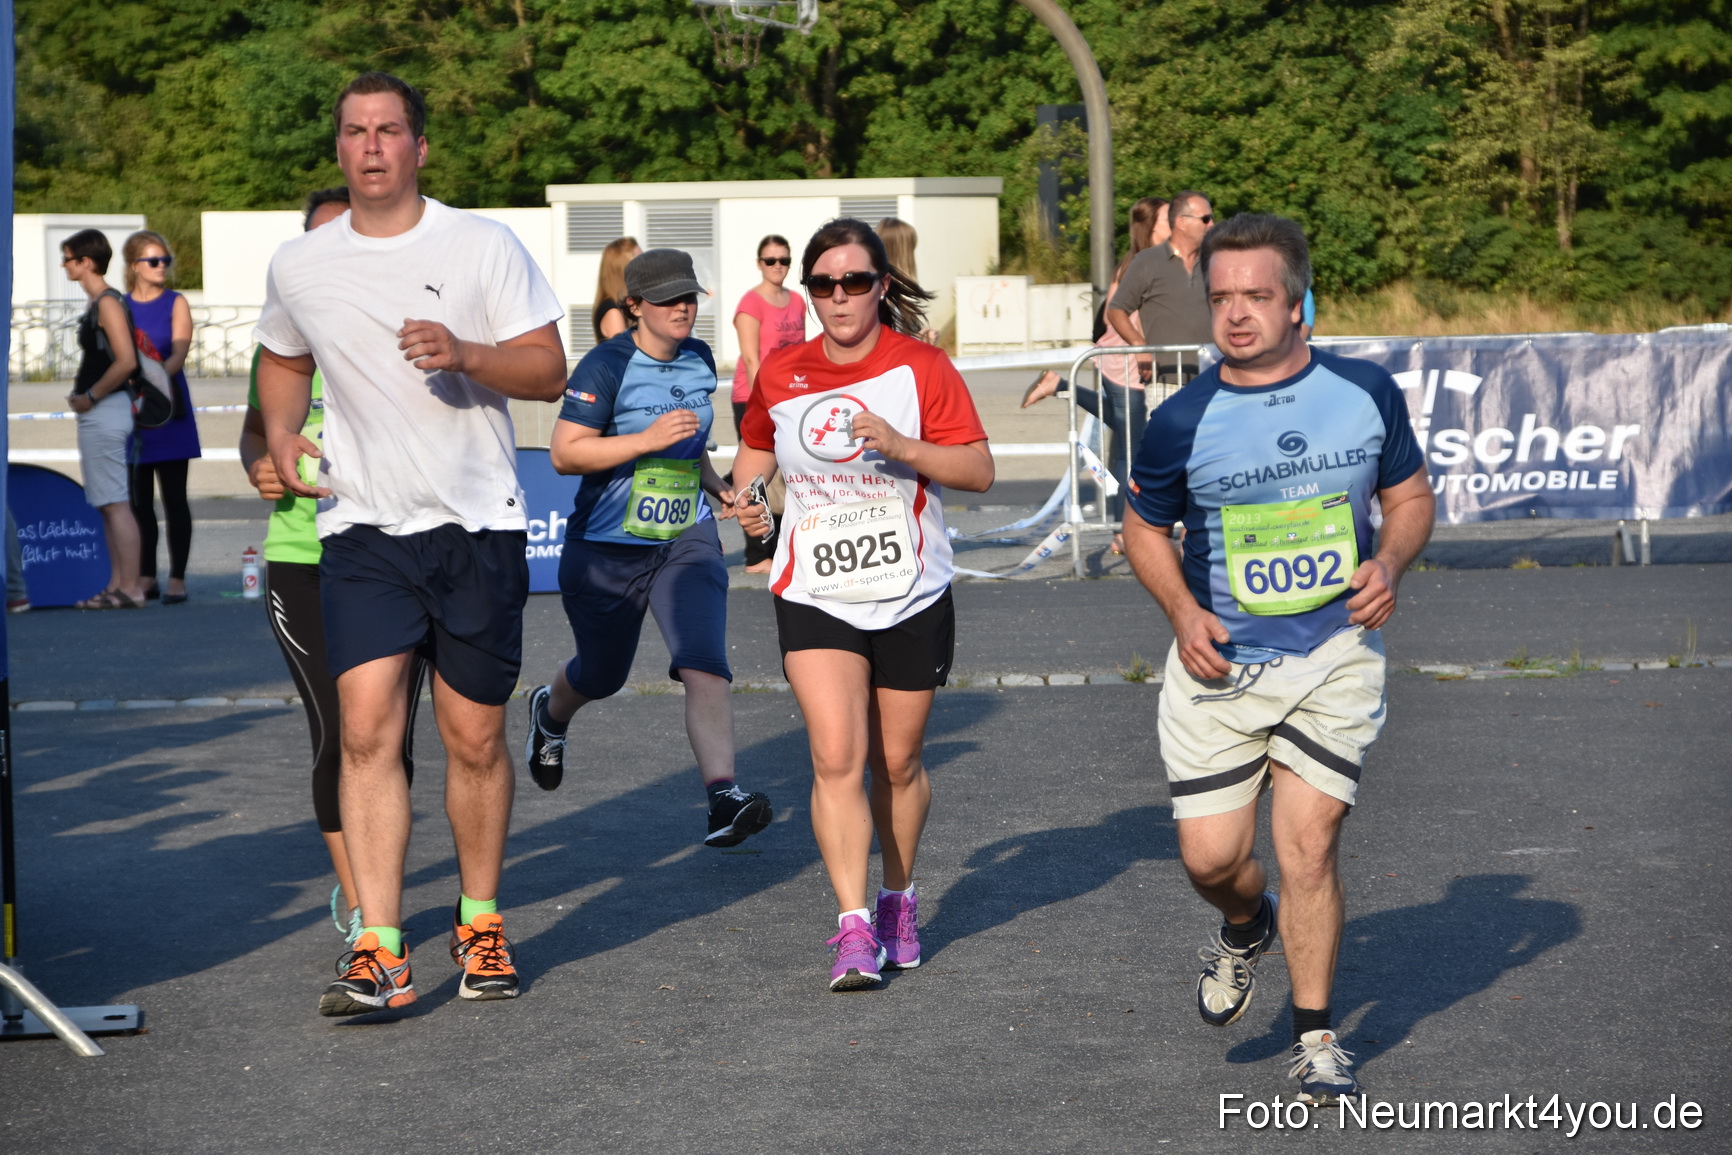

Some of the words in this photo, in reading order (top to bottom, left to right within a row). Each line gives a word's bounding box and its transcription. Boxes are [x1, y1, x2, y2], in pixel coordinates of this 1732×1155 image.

[1409, 412, 1641, 466] ischer
[831, 473, 856, 485] MIT
[1218, 447, 1368, 492] SCHABMÜLLER
[1428, 469, 1619, 495] UTOMOBILE
[838, 489, 853, 497] Dr.
[1279, 482, 1320, 499] TEAM
[637, 496, 691, 525] 6089
[800, 504, 888, 532] df-sports
[1228, 513, 1262, 525] 2013
[38, 519, 96, 539] Lächeln
[65, 543, 98, 560] mit!
[812, 530, 902, 577] 8925
[811, 567, 914, 594] www.df-sports.de
[1244, 549, 1345, 595] 6092
